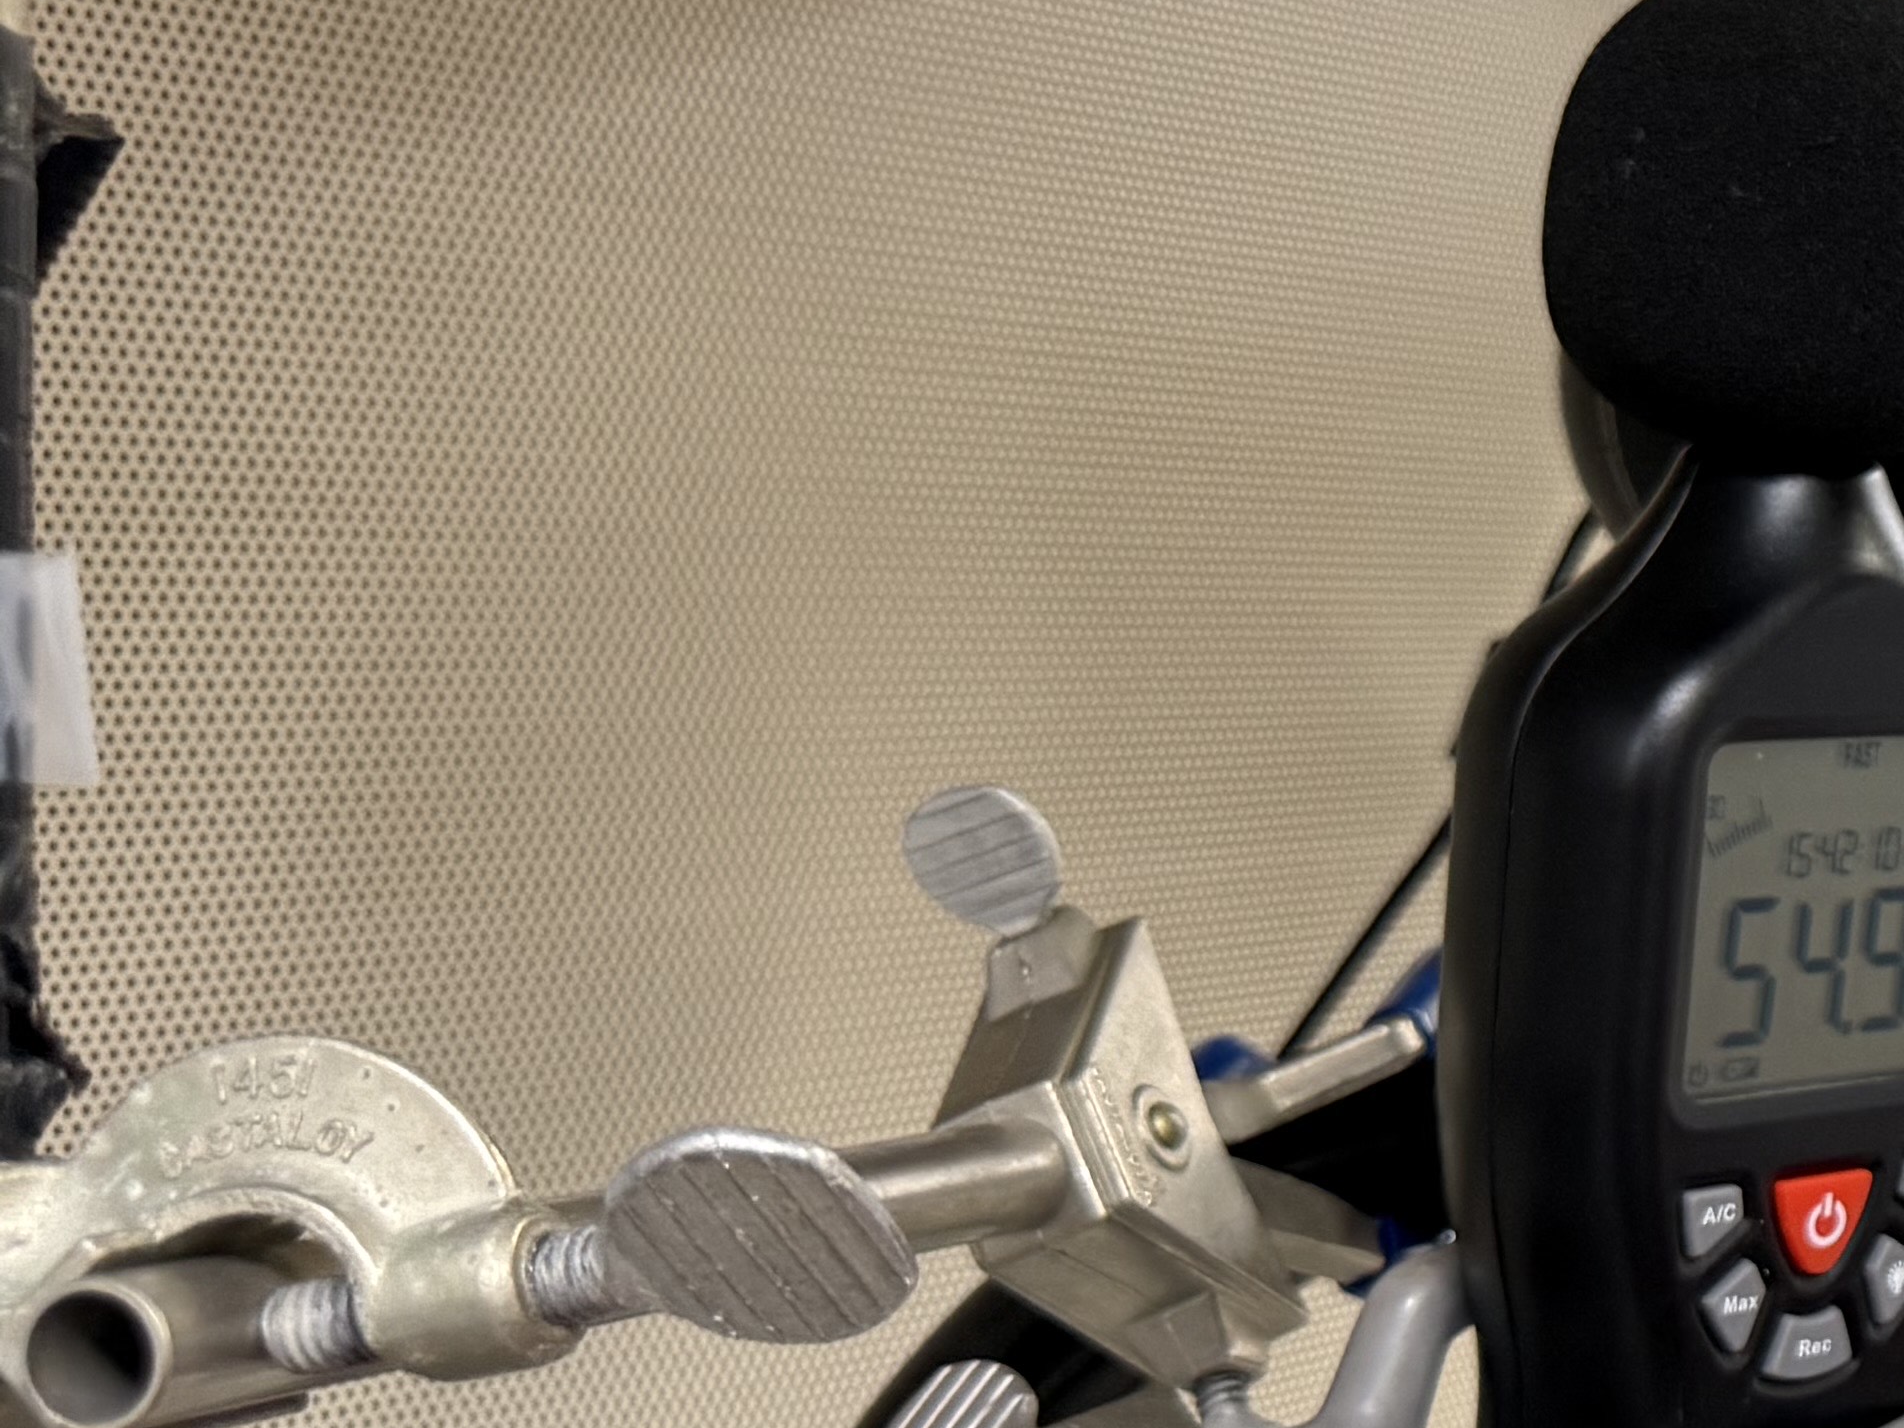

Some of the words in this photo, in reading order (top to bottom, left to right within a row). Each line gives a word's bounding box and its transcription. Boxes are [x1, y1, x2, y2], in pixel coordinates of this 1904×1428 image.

[1702, 1202, 1738, 1225] A/C
[1723, 1294, 1759, 1315] Max
[1799, 1338, 1832, 1357] Rec
